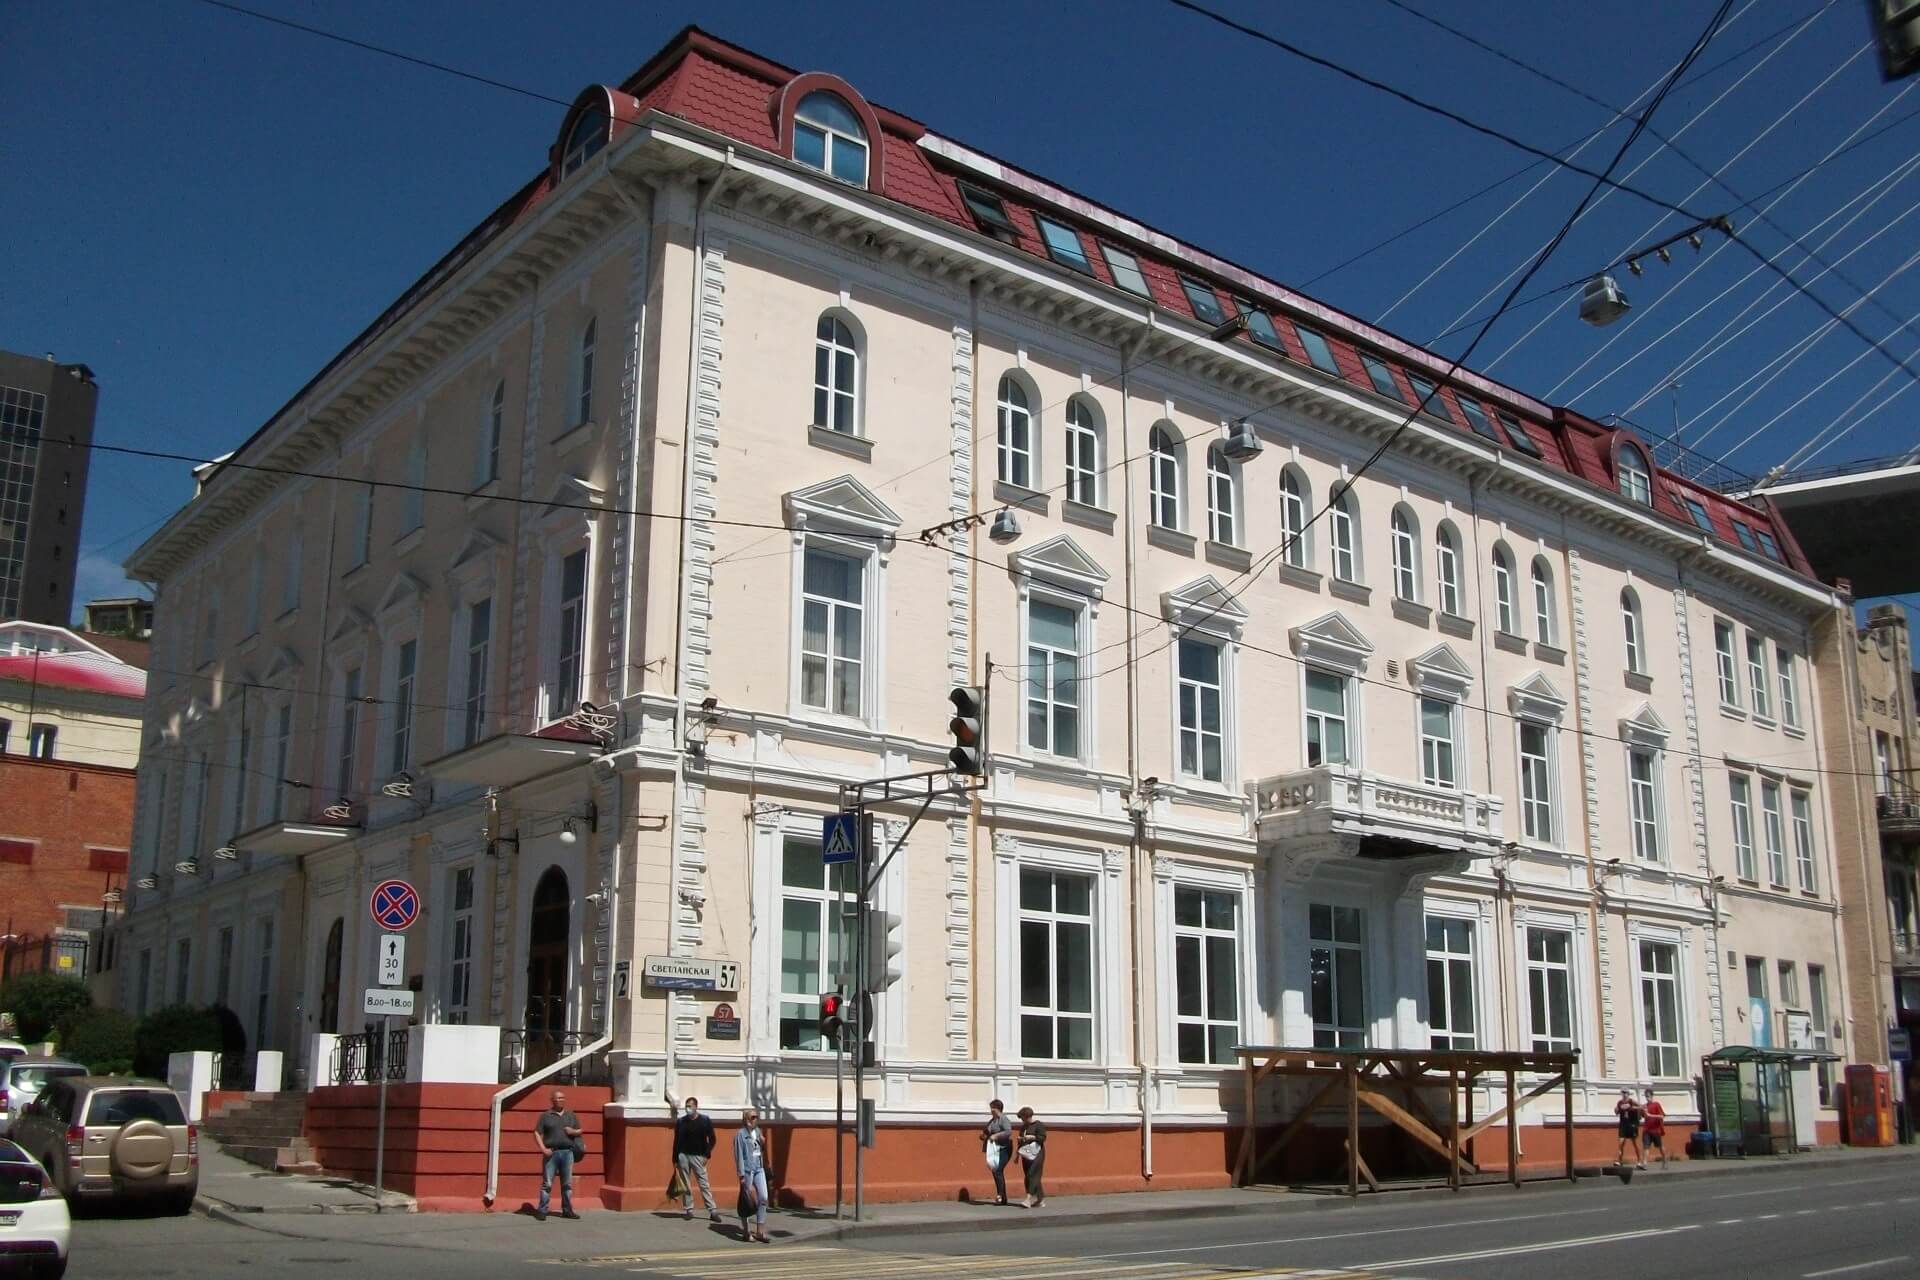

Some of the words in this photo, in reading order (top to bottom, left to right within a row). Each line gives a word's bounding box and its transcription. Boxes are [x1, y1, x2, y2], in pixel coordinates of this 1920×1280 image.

[385, 958, 398, 968] 30
[651, 964, 710, 976] СВЕТЛАНСКАЯ
[720, 965, 736, 988] 57
[618, 973, 627, 996] 2
[718, 1007, 730, 1019] 57
